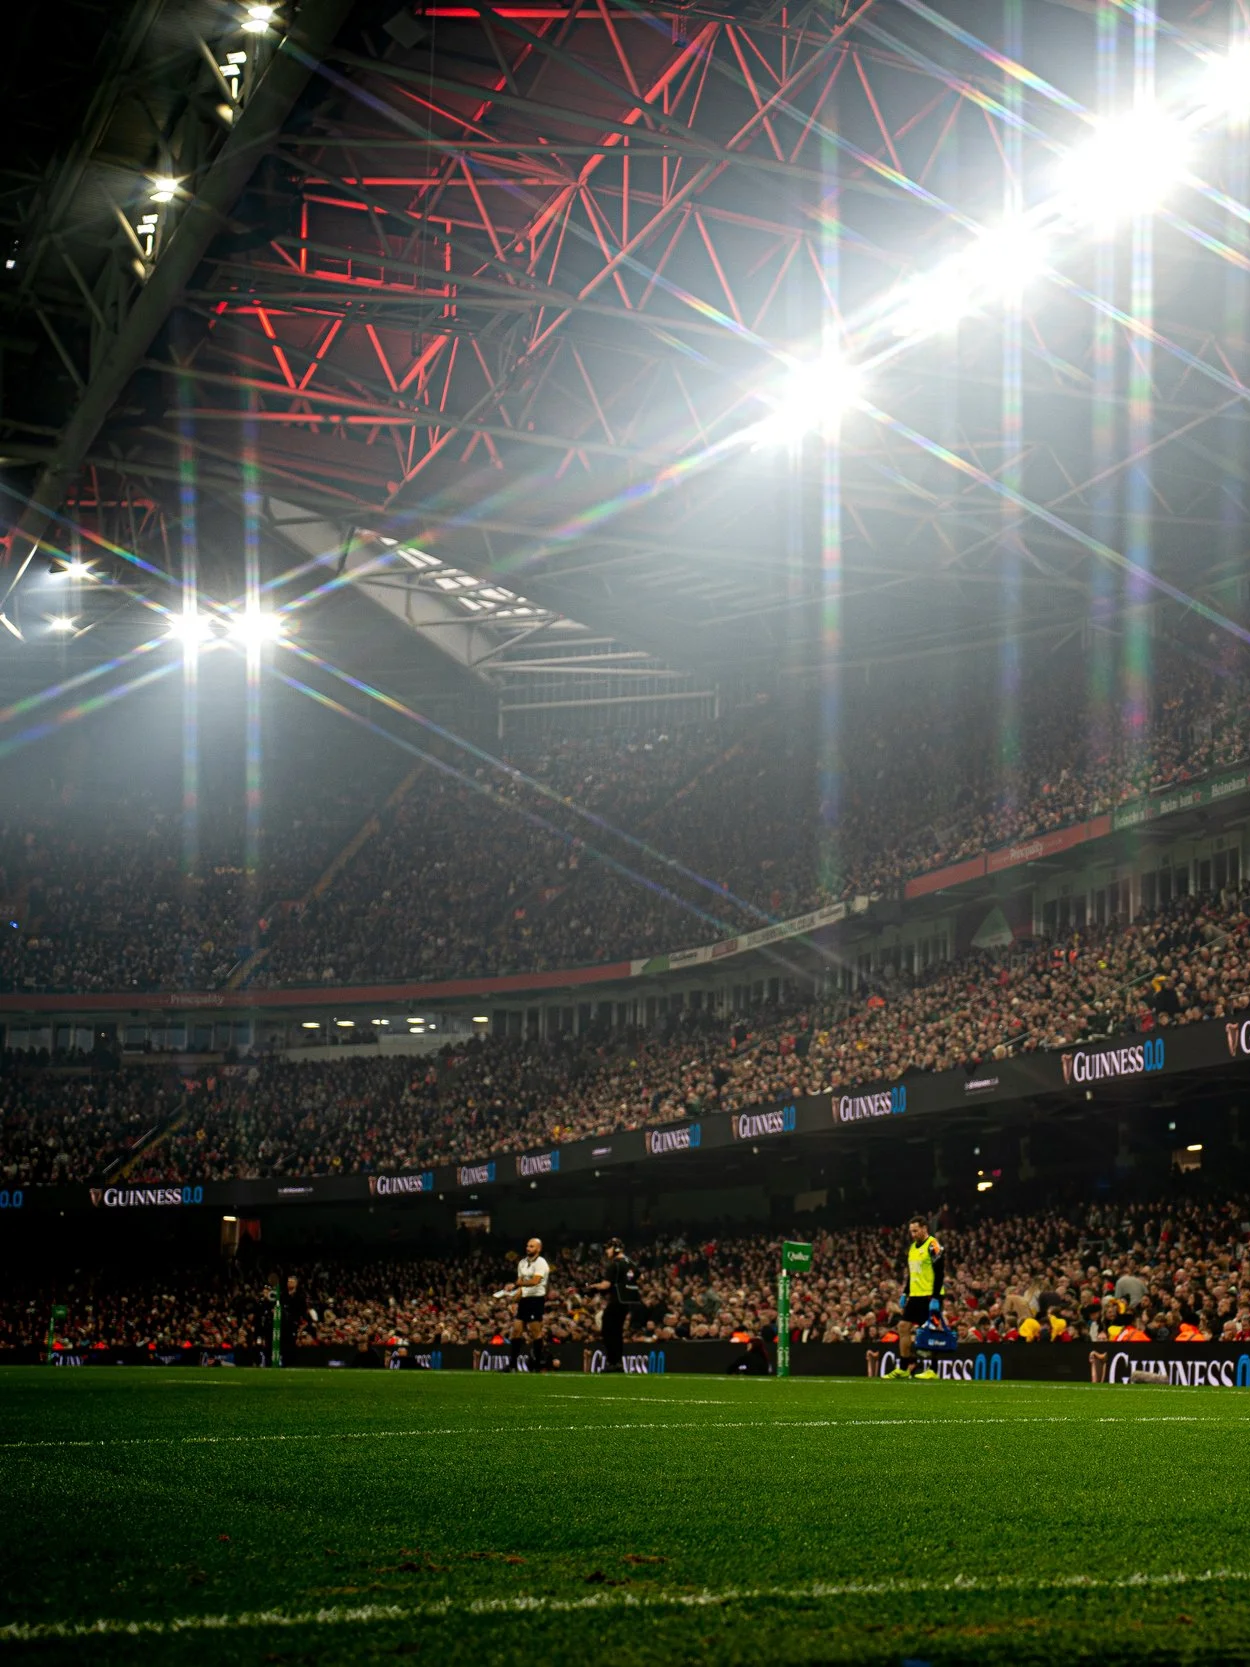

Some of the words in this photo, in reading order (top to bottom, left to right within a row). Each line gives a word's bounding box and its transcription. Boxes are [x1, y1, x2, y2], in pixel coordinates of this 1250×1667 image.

[1073, 1046, 1144, 1083] GUINNESS
[1144, 1037, 1165, 1071] 0.0
[838, 1090, 892, 1122] GUINNESS
[738, 1110, 784, 1139] GUINNESS
[0, 1189, 24, 1209] 0.0
[104, 1187, 182, 1208] GUINNESS
[182, 1185, 204, 1205] 0.0
